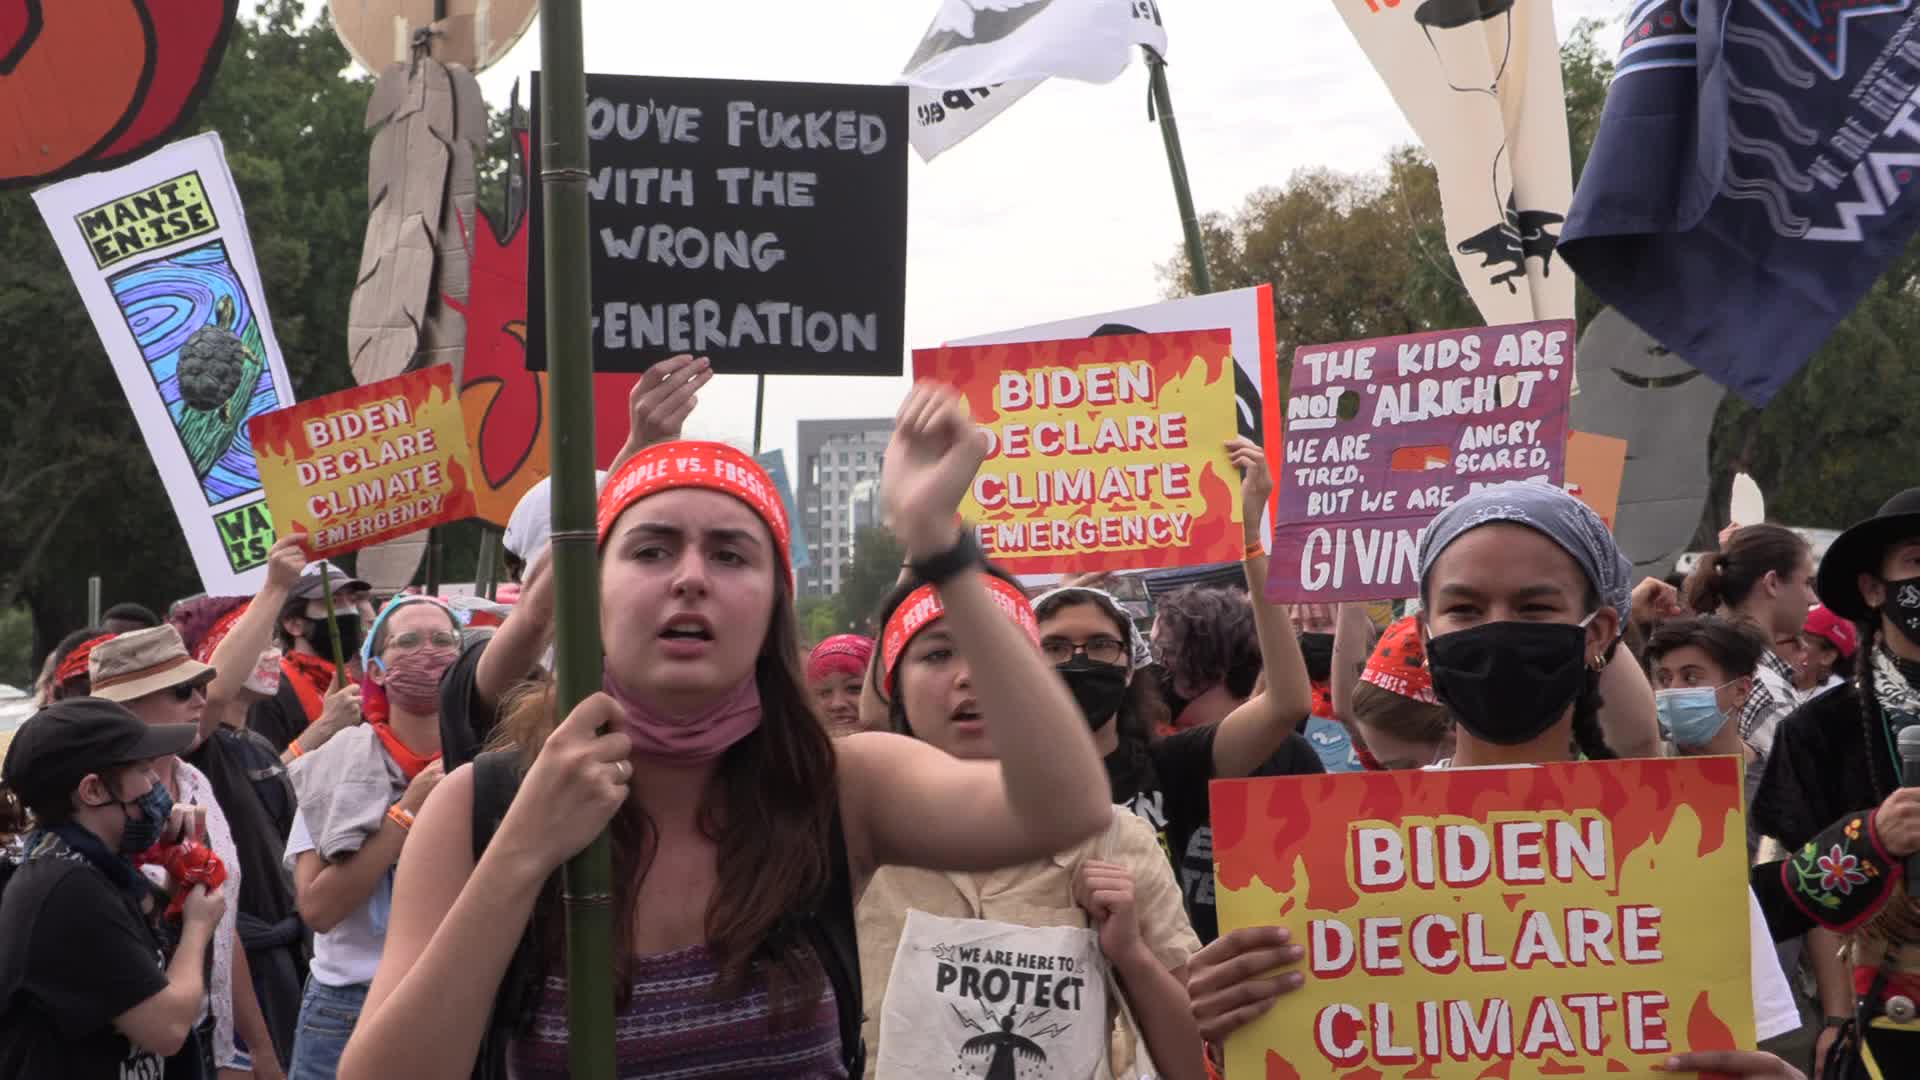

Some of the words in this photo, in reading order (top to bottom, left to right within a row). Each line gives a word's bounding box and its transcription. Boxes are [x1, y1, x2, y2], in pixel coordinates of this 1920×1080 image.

[584, 96, 702, 143] OU'VE
[727, 101, 887, 155] FUCKED
[717, 167, 817, 207] THE
[1802, 84, 1920, 241] WAT
[600, 224, 786, 272] WRONG
[591, 299, 877, 353] ENERATION
[1302, 346, 1377, 385] THE
[1397, 334, 1482, 377] KIDS
[1494, 330, 1568, 367] ARE
[1000, 365, 1154, 410] BIDEN
[1288, 386, 1345, 421] NOT
[307, 398, 411, 448] BIDEN
[296, 428, 436, 487] DECLARE
[675, 457, 707, 473] VS.
[1287, 438, 1320, 463] WE
[1321, 433, 1371, 463] ARE
[1455, 447, 1551, 475] SCARED,
[308, 461, 441, 519] CLIMATE
[973, 462, 1192, 509] CLIMATE
[1307, 488, 1354, 516] BUT
[1360, 489, 1398, 512] WE
[1407, 485, 1455, 510] ARE
[314, 494, 443, 547] EMERGENCY
[975, 511, 1193, 554] EMERGENCY
[1301, 528, 1426, 591] GIVIN
[1353, 817, 1608, 892] BIDEN
[959, 946, 981, 963] WE
[982, 949, 1013, 966] ARE
[1016, 952, 1054, 970] HERE
[1057, 955, 1075, 972] TO
[1307, 904, 1664, 979] DECLARE
[935, 962, 1085, 1011] PROTECT
[1314, 992, 1671, 1065] CLIMATE
